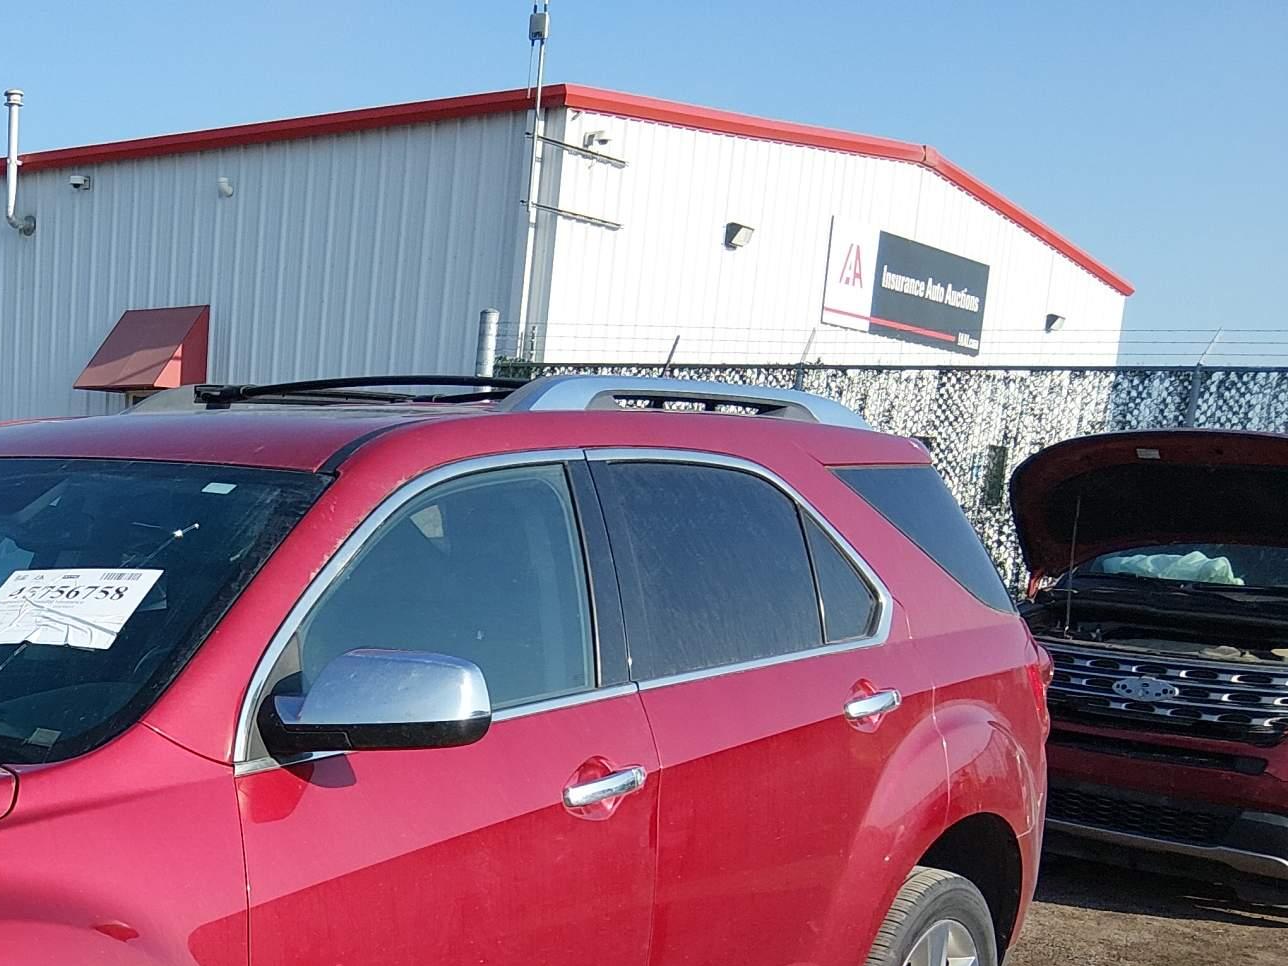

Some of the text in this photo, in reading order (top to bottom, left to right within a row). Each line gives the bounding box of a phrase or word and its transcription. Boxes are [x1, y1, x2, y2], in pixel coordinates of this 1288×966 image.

[881, 264, 980, 313] Insurance Auto Auctions
